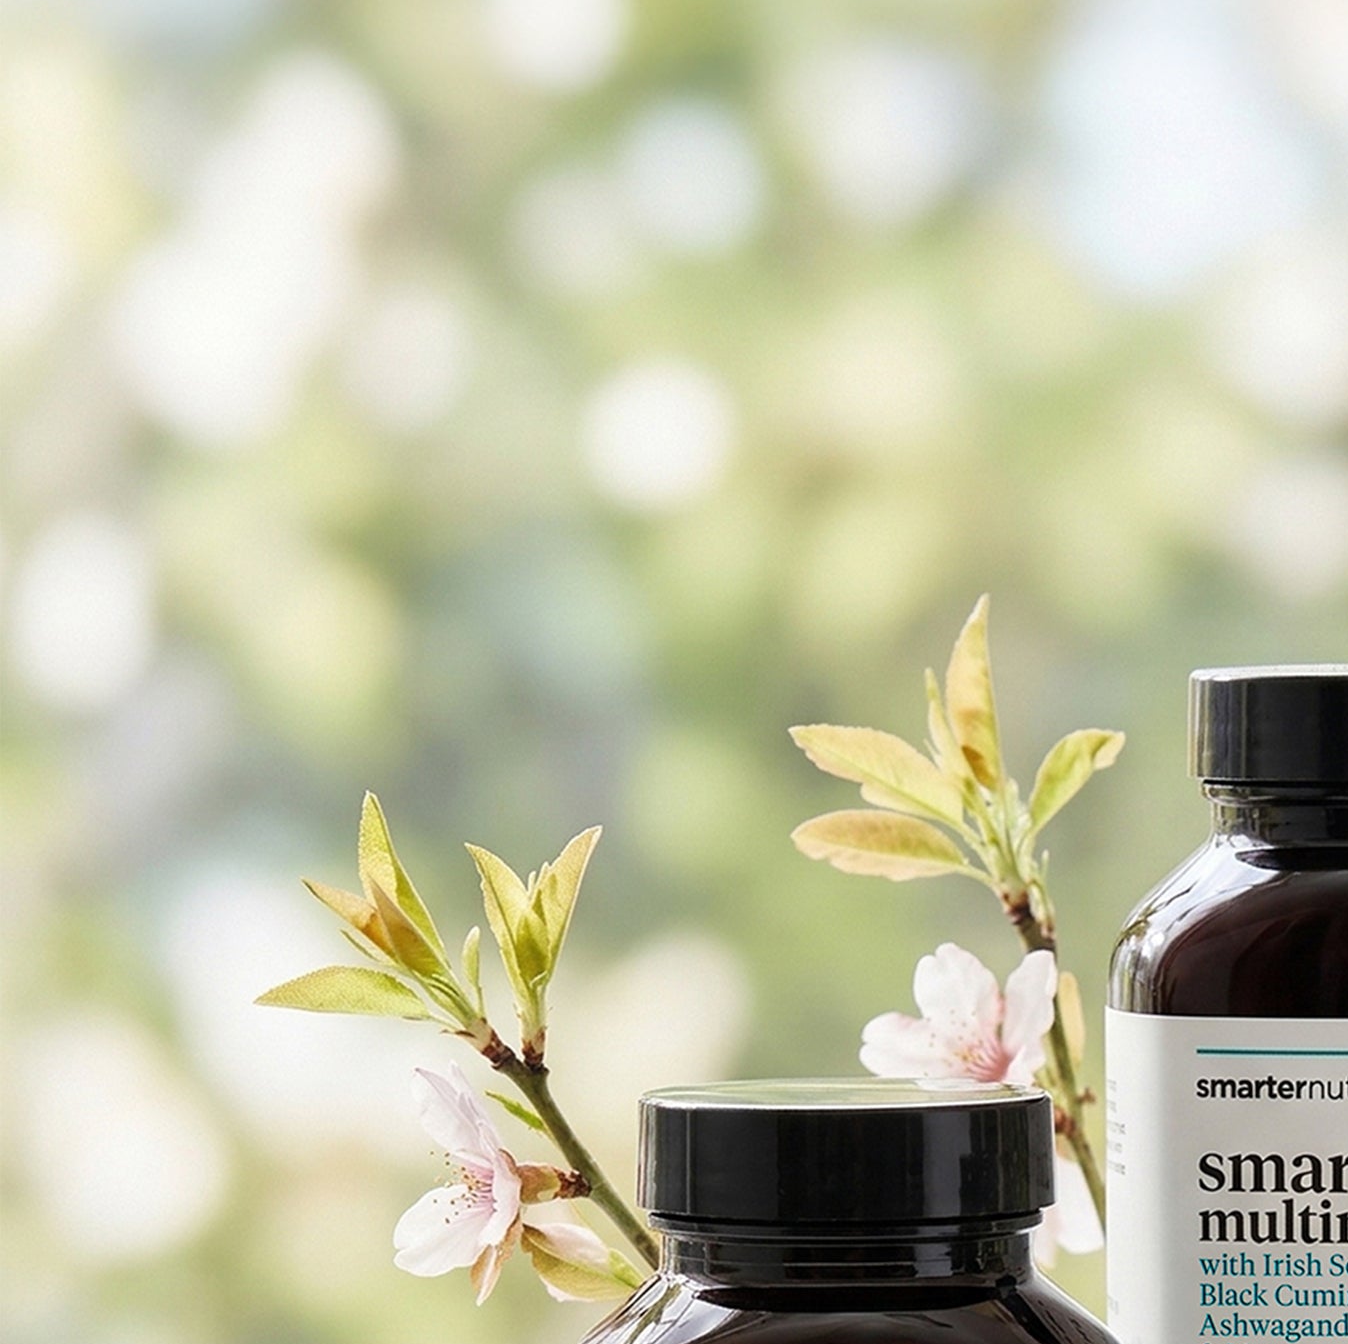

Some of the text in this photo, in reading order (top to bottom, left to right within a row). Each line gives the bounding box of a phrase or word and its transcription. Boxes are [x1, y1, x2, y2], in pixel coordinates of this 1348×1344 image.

[1199, 1252, 1256, 1276] with
[1263, 1252, 1323, 1277] Irish
[1200, 1282, 1268, 1306] Black
